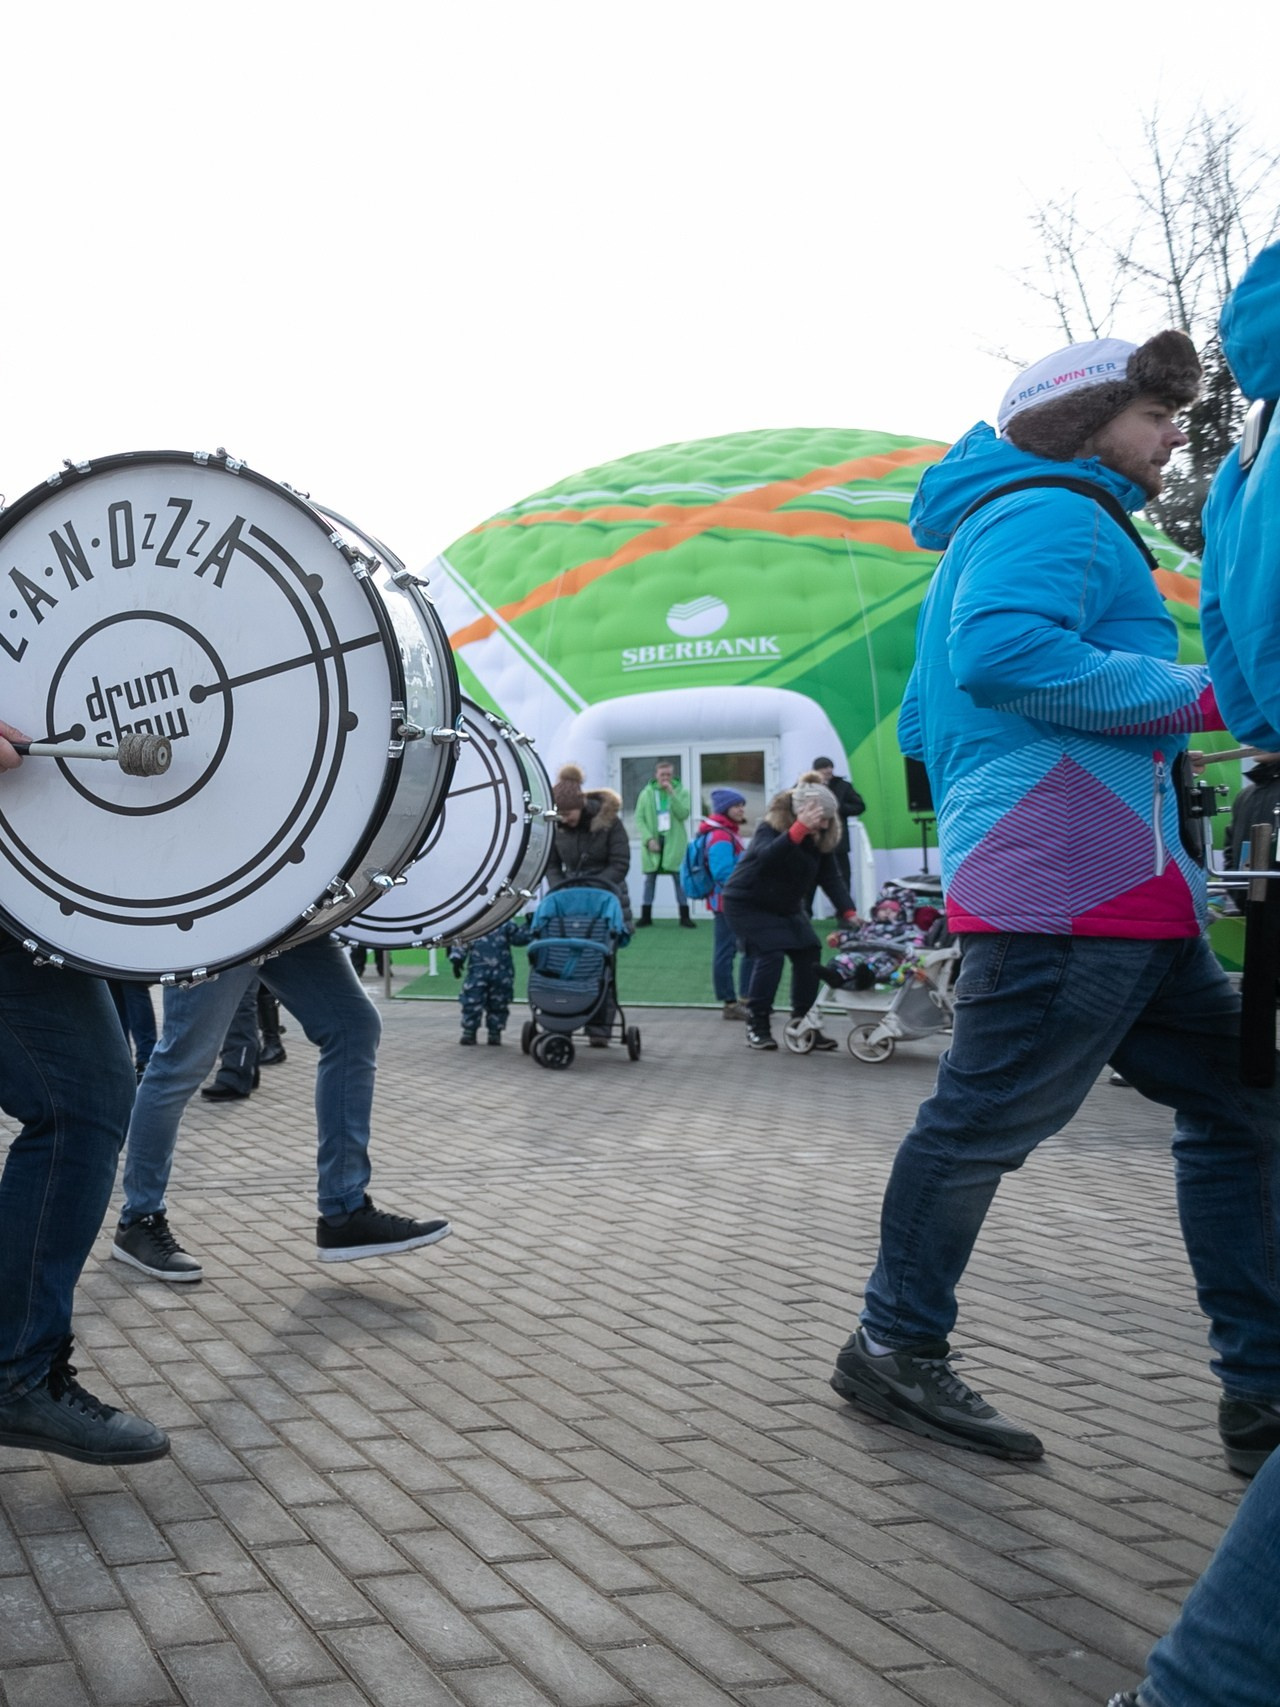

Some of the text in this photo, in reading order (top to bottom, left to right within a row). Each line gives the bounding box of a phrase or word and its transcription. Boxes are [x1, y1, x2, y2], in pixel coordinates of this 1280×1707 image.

[1018, 361, 1117, 401] REALWINTER
[621, 635, 781, 666] SBERBANK
[86, 667, 179, 722] drum
